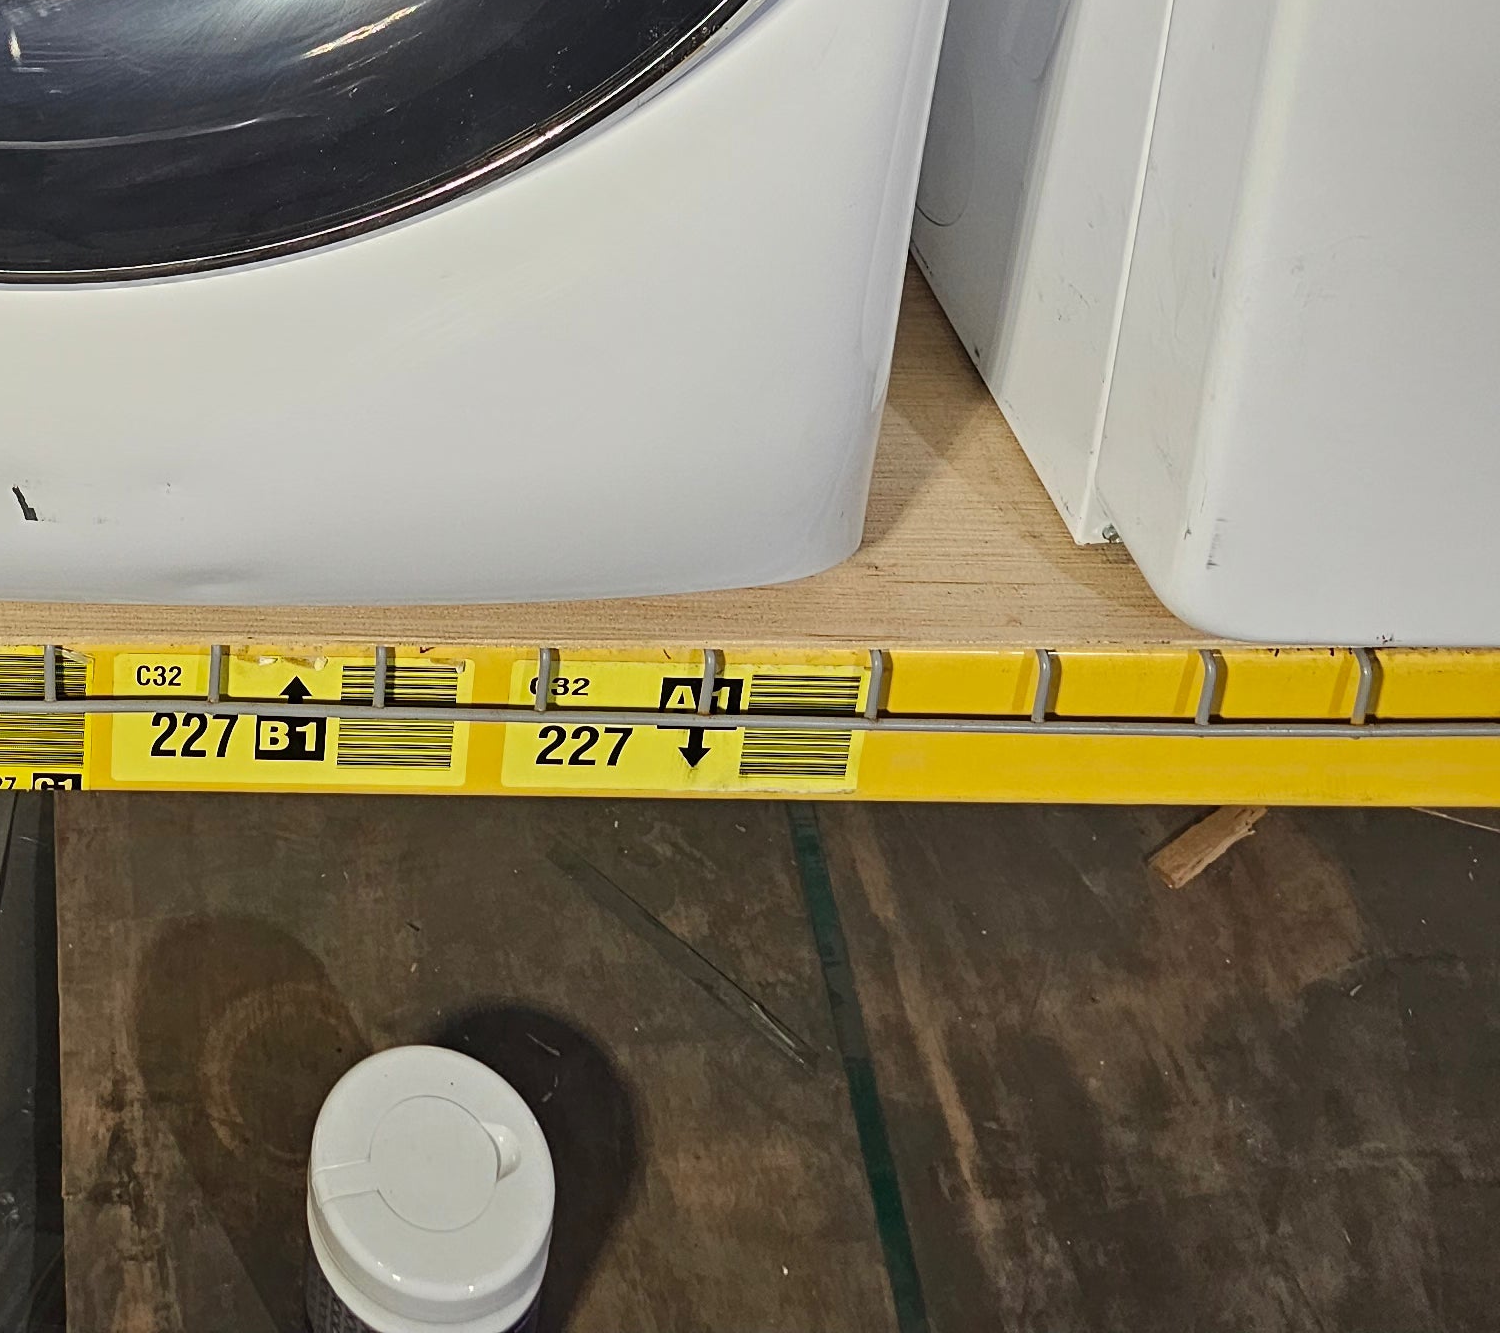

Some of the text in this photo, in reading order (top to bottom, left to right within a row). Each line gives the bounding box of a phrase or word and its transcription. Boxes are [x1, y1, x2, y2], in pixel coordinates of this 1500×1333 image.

[136, 665, 182, 687] C32
[150, 711, 318, 758] 227 B1
[535, 724, 634, 767] 227
